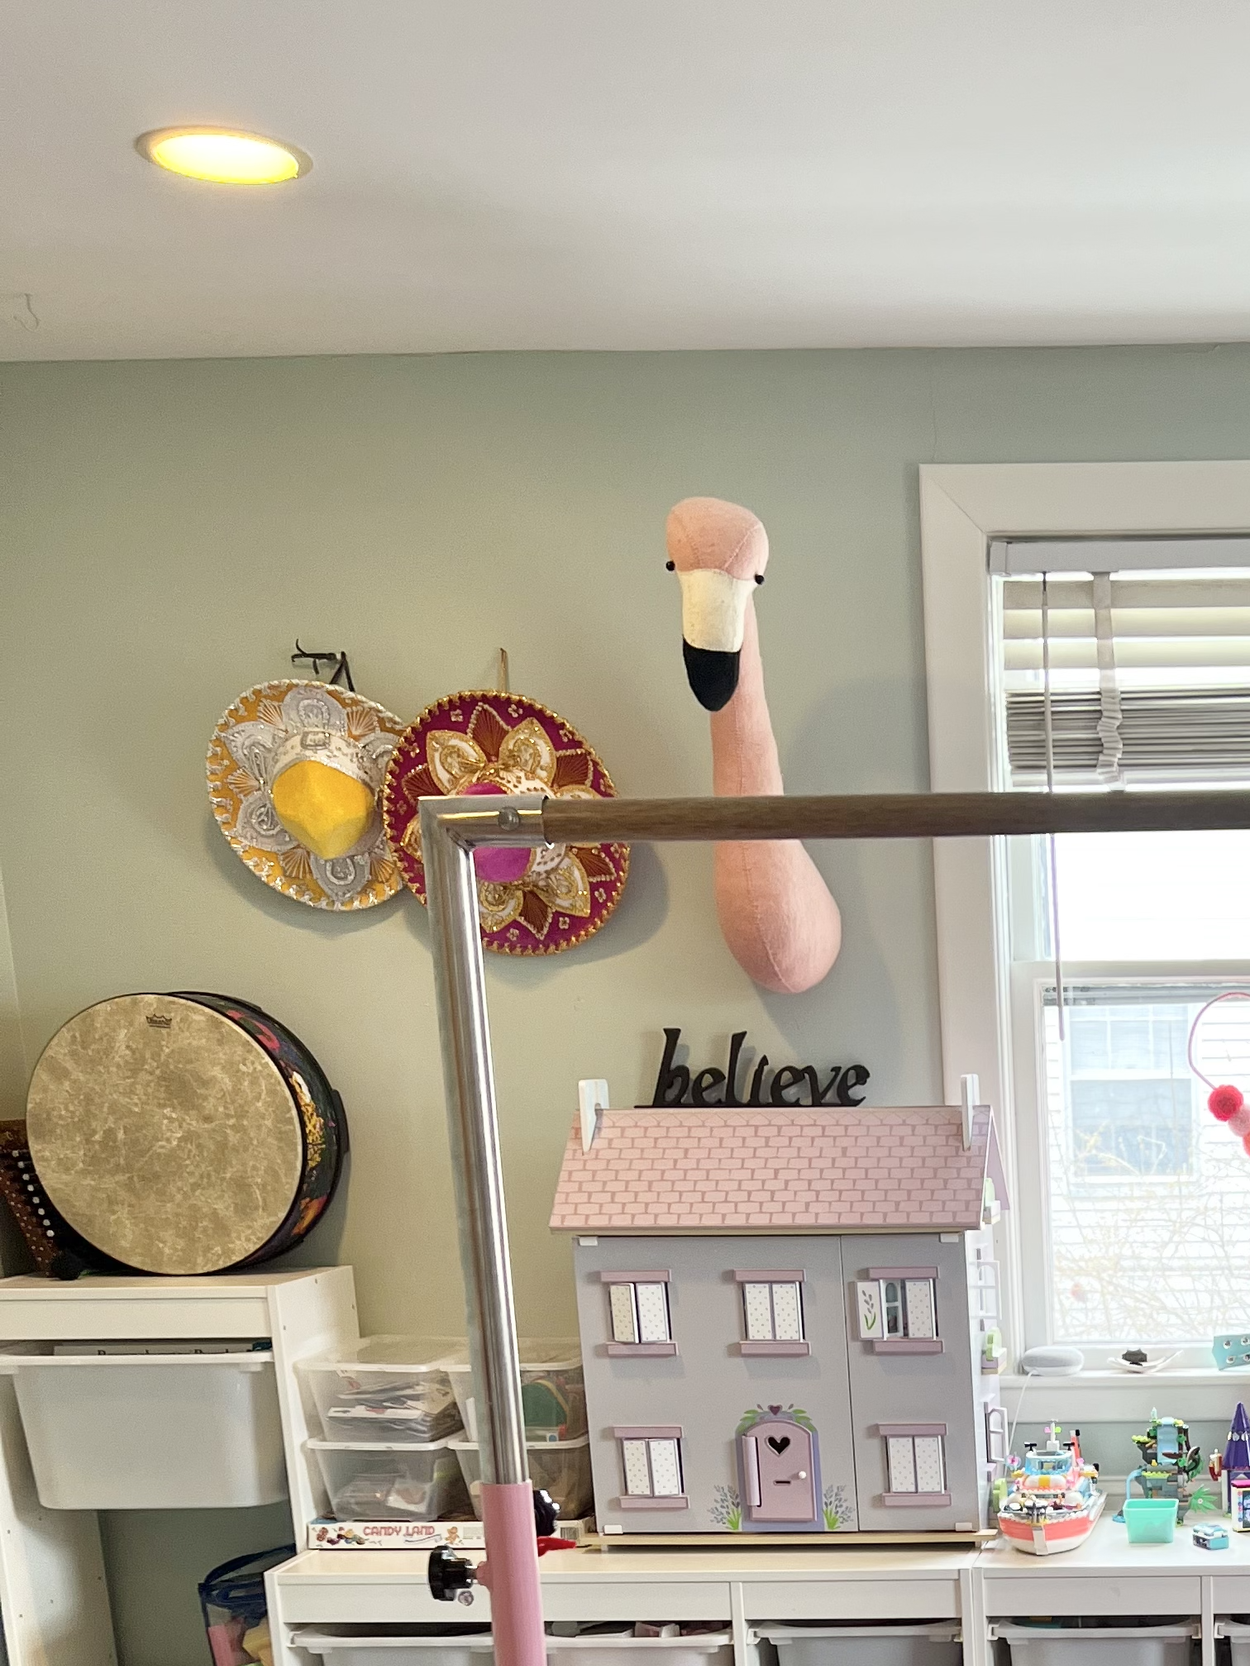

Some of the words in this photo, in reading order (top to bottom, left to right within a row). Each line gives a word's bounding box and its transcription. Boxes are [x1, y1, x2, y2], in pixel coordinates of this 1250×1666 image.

[651, 1028, 871, 1108] believe
[363, 1526, 402, 1536] CANDY
[404, 1525, 435, 1537] LAND
